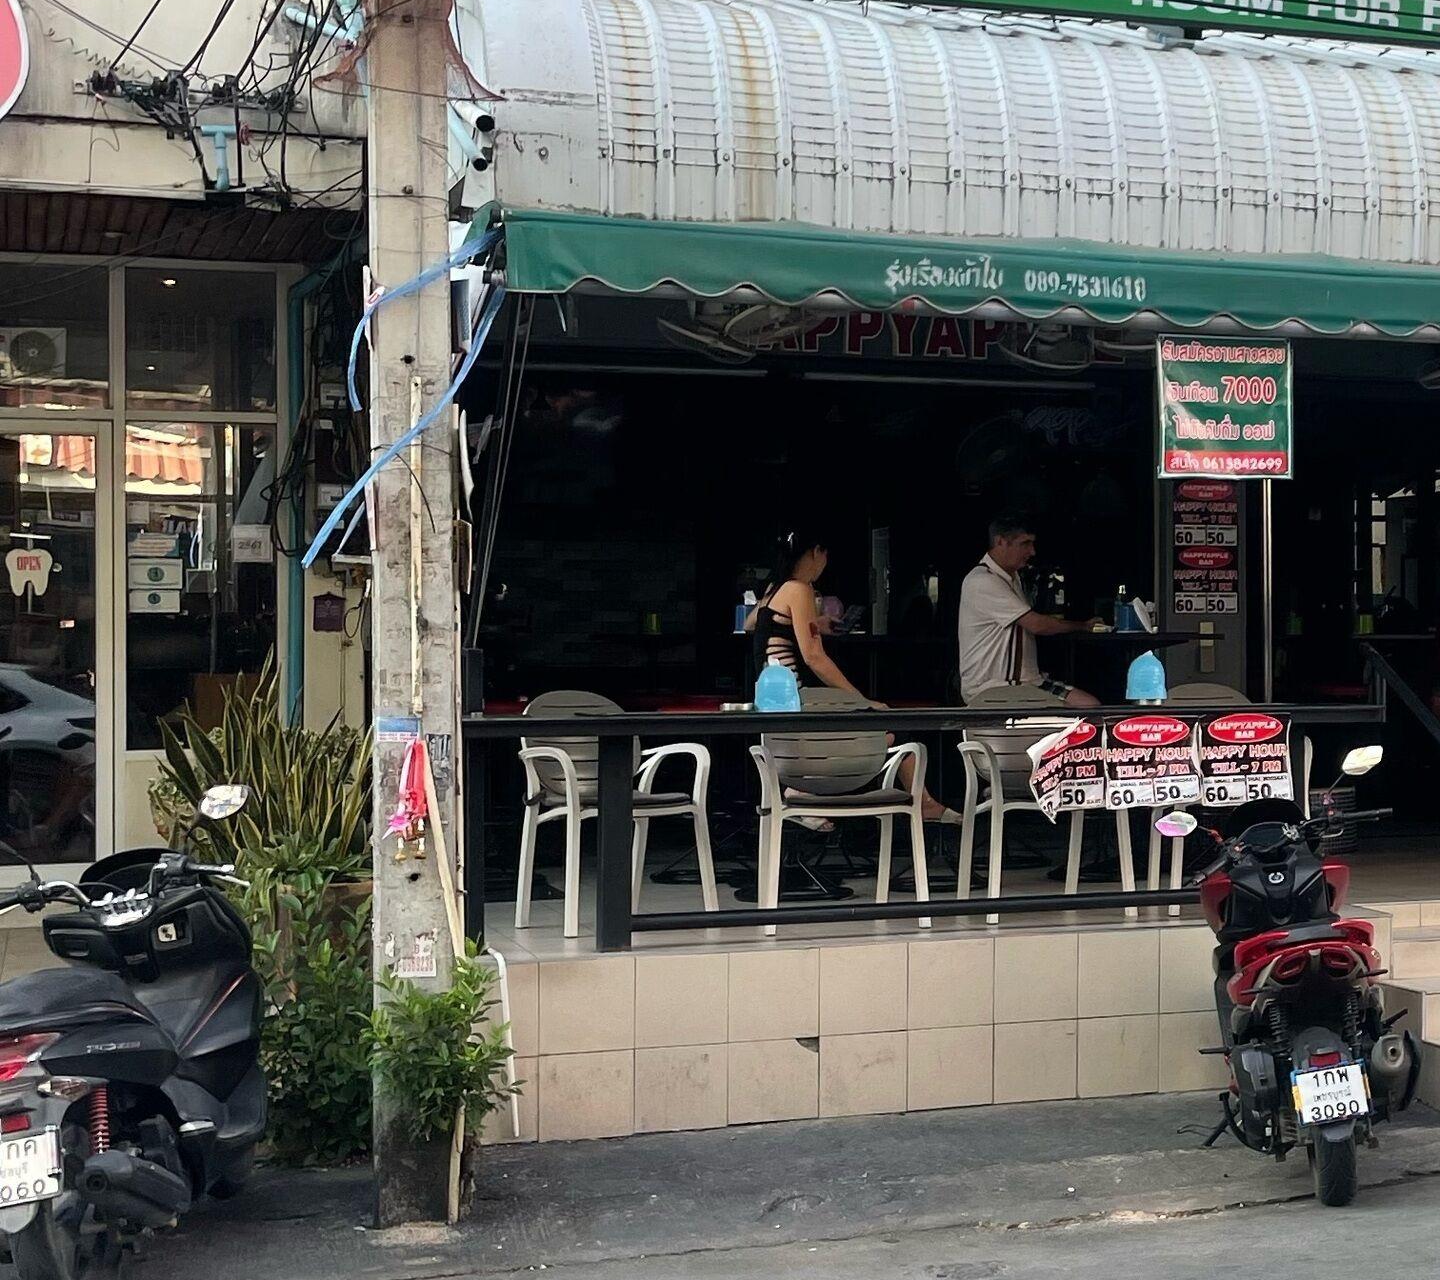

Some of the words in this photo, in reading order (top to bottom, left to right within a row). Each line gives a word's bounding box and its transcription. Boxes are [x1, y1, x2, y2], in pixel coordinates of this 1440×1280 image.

[1221, 376, 1277, 404] 7000
[1176, 531, 1193, 544] 60
[1207, 532, 1225, 544] 50
[1176, 599, 1193, 612] 60
[1207, 600, 1225, 612] 50
[1063, 747, 1105, 763] HOUR
[1106, 747, 1153, 762] HAPPY
[1201, 745, 1248, 760] HAPPY
[1076, 765, 1097, 778] PM
[1250, 761, 1260, 773] 7
[1262, 760, 1282, 773] PM
[1062, 789, 1086, 805] 50
[1111, 789, 1135, 806] 60
[1156, 785, 1180, 801] 50
[1206, 785, 1229, 802] 60
[1248, 782, 1272, 800] 50
[1311, 1100, 1360, 1121] 3090
